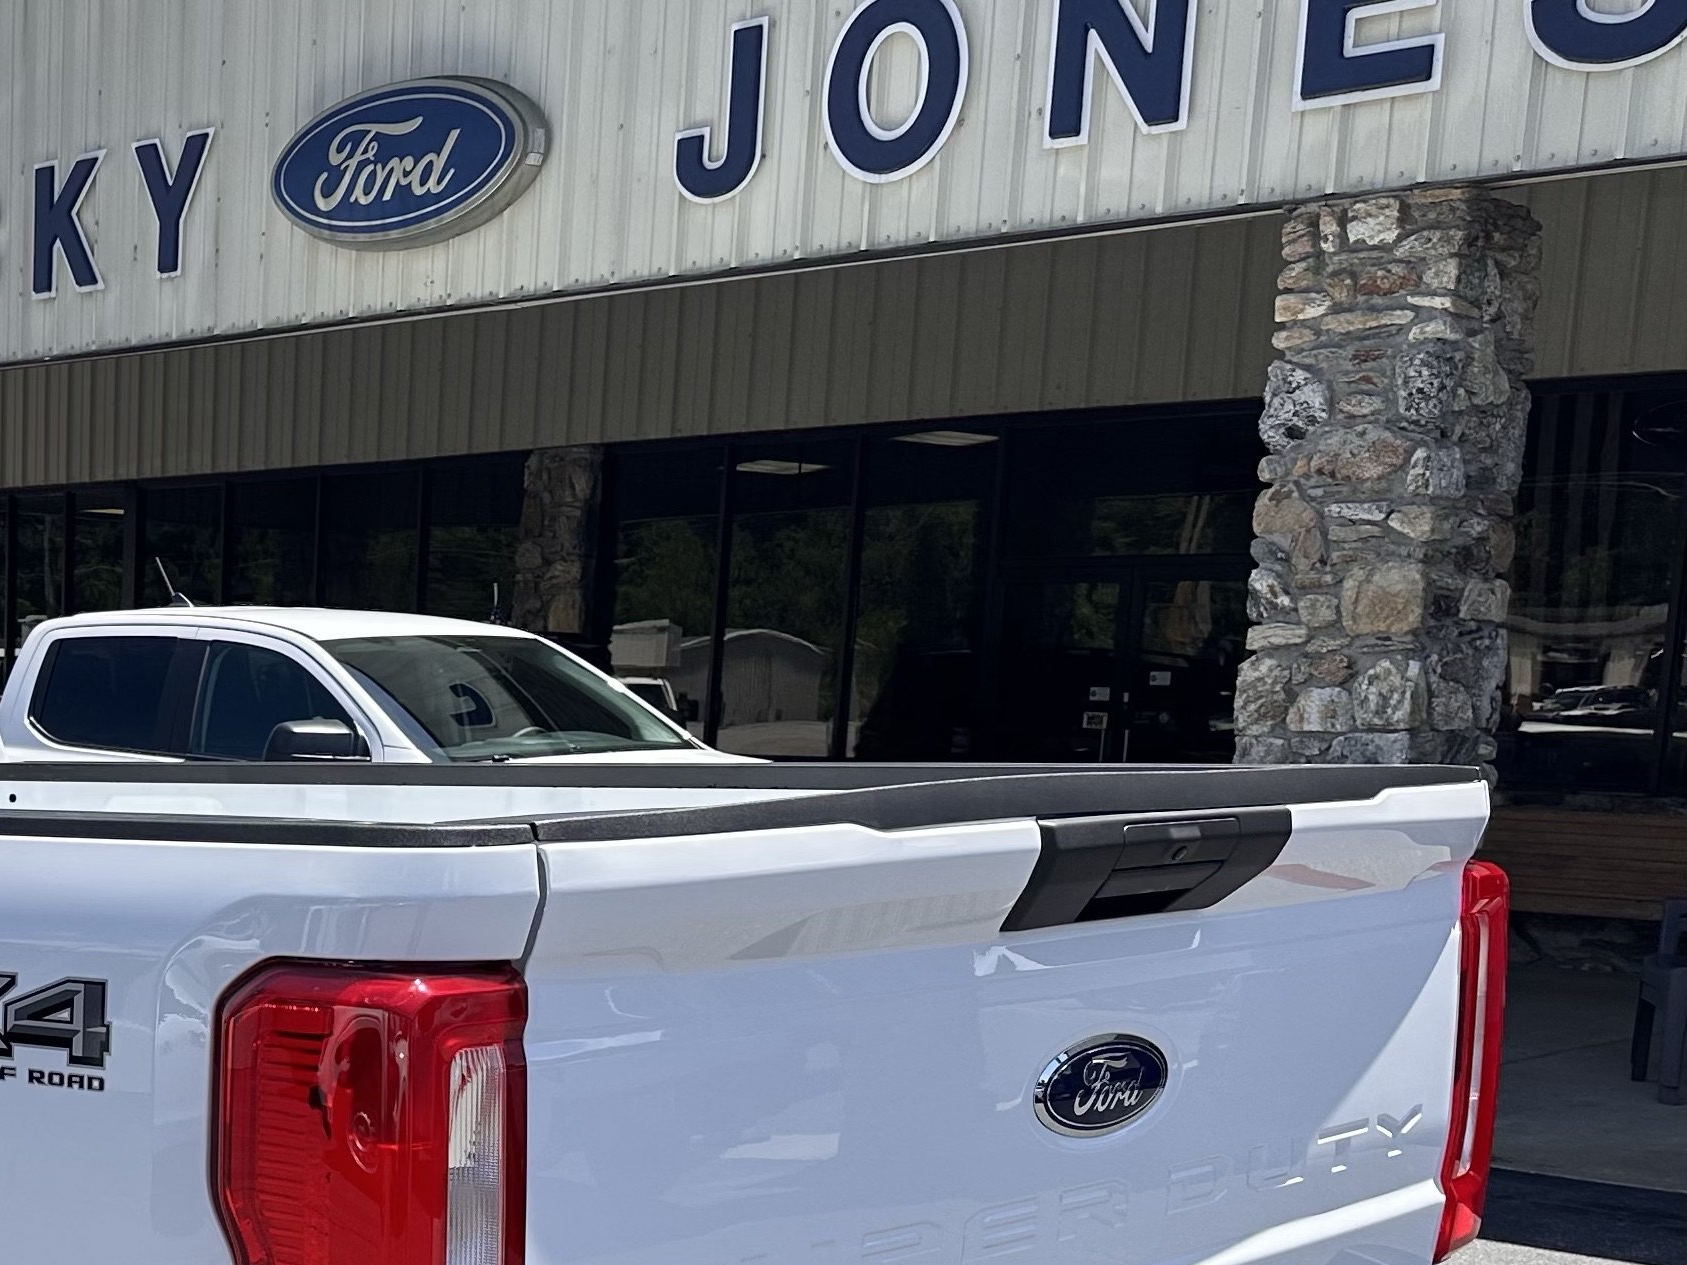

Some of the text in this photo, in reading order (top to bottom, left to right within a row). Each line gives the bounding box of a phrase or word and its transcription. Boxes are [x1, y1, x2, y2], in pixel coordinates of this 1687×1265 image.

[314, 115, 462, 212] Ford
[27, 1068, 105, 1092] ROAD
[1073, 1052, 1144, 1117] Ford
[1166, 1103, 1423, 1216] DUTY
